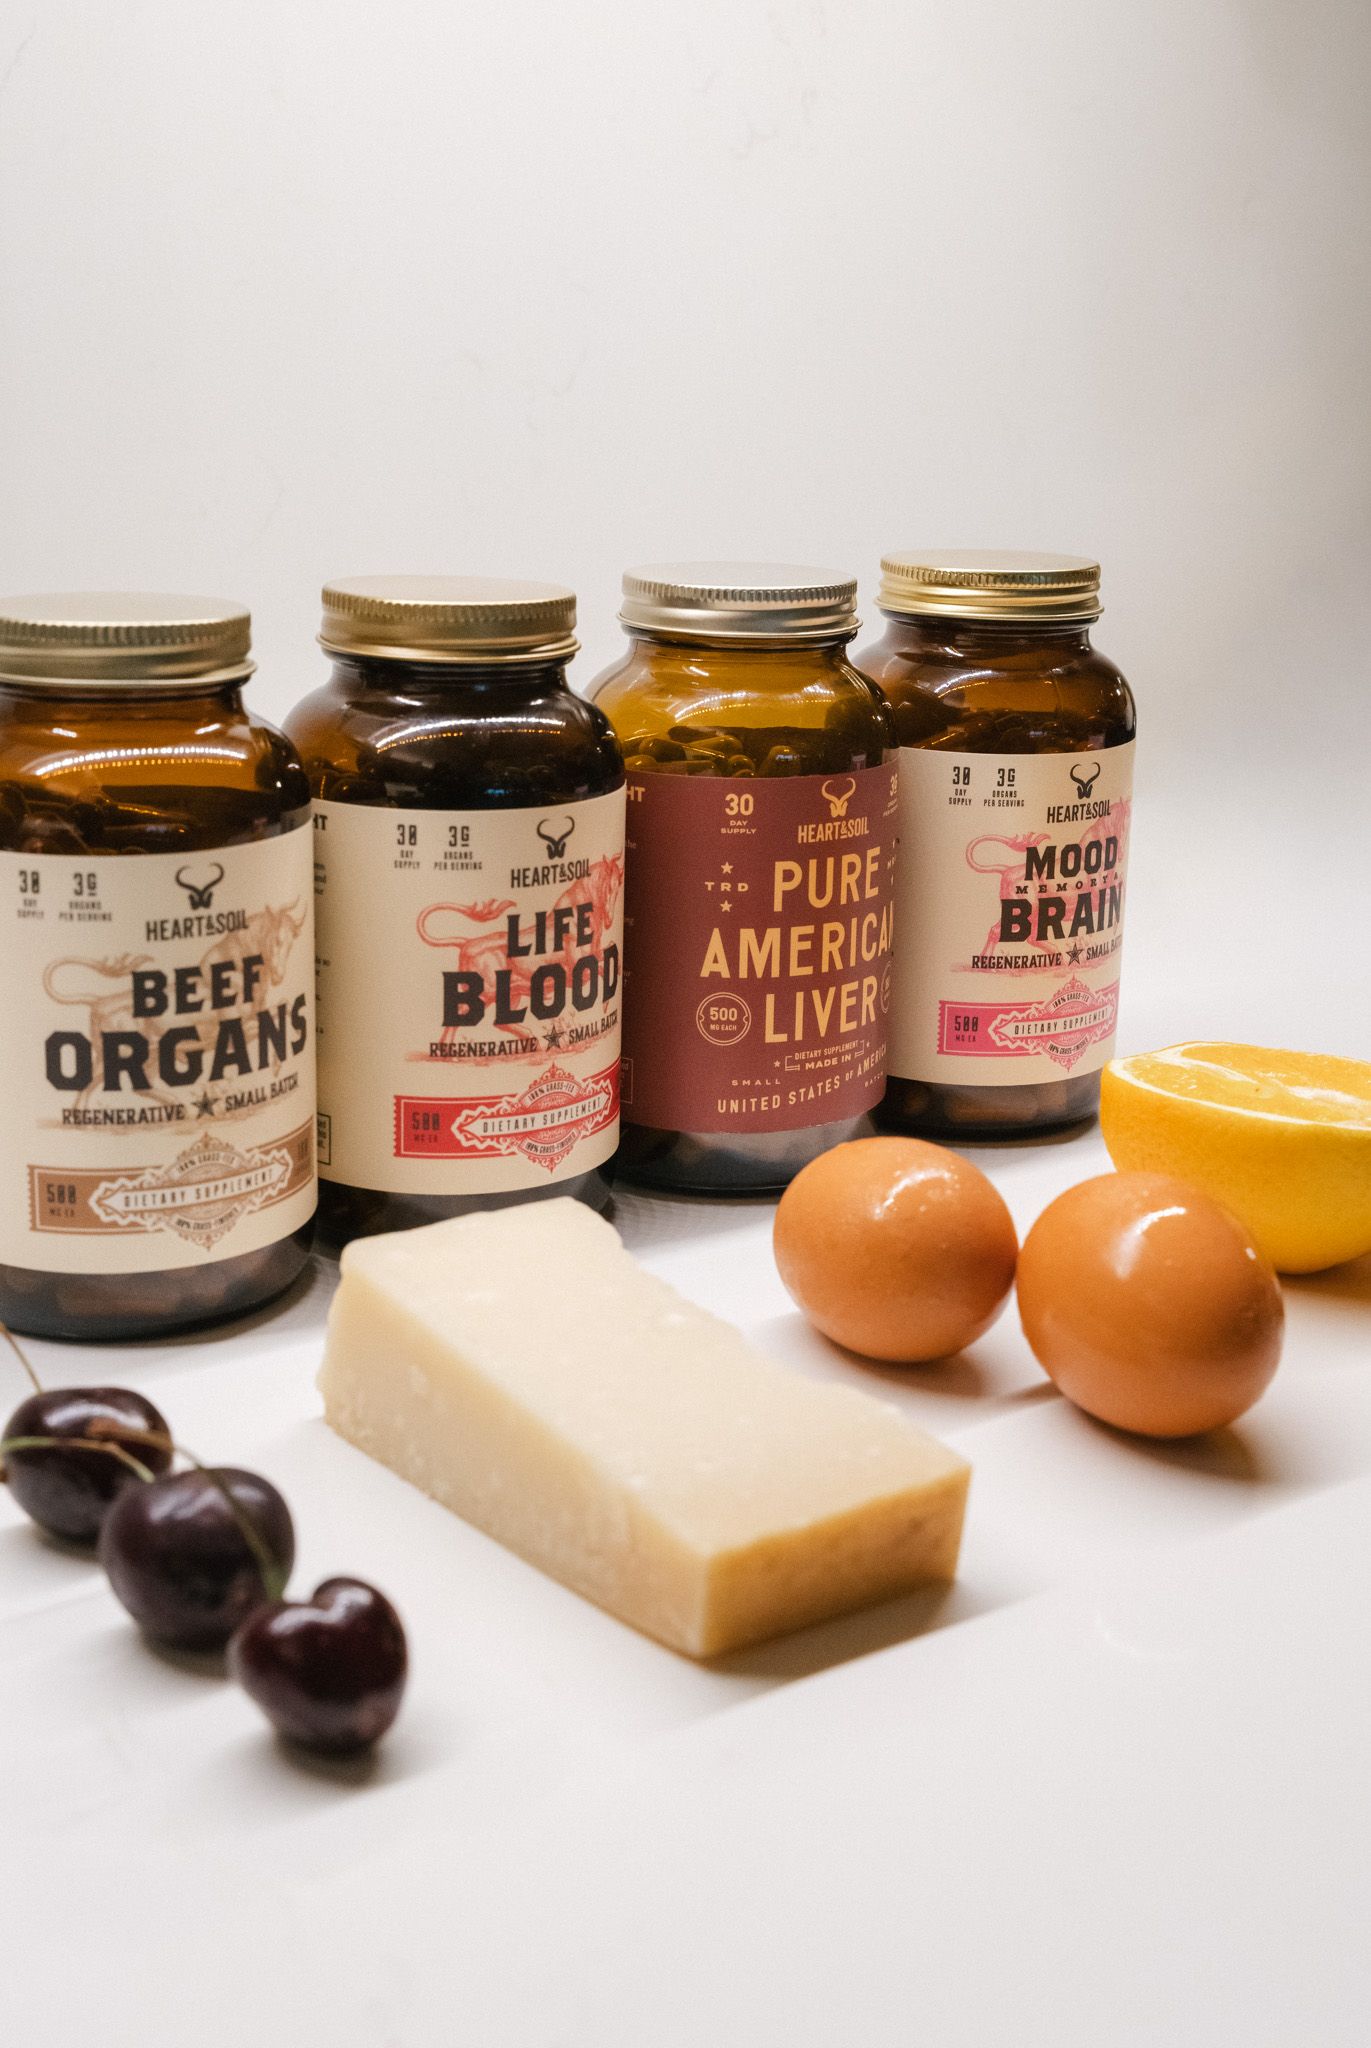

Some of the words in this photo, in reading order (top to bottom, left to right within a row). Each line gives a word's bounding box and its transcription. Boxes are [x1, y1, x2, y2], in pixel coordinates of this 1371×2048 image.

[953, 766, 971, 785] 30
[997, 768, 1015, 787] 3G
[725, 793, 754, 816] 30
[948, 797, 972, 806] SUPPLY
[983, 799, 995, 807] PER
[998, 799, 1024, 807] SERVING
[992, 790, 1017, 798] ORGANS
[1046, 800, 1112, 823] HEART&SOIL
[397, 824, 417, 846] 30
[449, 826, 470, 847] 3G
[798, 817, 869, 843] HEART&SOIL
[1024, 836, 1118, 881] MOOD
[74, 873, 97, 896] 3G
[510, 859, 591, 888] HEART&SOIL
[773, 847, 880, 913] PURE
[1015, 875, 1109, 895] MEMORY
[146, 909, 249, 941] HEART&SOIL
[999, 881, 1123, 942] BRAIN
[507, 902, 594, 958] LIFE
[971, 953, 1062, 969] REGENERATIVE
[1086, 940, 1110, 960] SMALL
[132, 954, 265, 1018] BEEF
[442, 943, 619, 1027] BLOOD
[709, 1007, 738, 1021] 500
[764, 975, 878, 1043] LIVER
[1014, 1022, 1058, 1035] DIETARY
[1063, 1007, 1108, 1030] SUPPLEMENT
[954, 1016, 979, 1032] 500
[45, 993, 307, 1092] ORGANS
[429, 1037, 538, 1058] REGENERATIVE
[568, 1021, 599, 1044] SMALL
[795, 1046, 822, 1060] DIETARY
[824, 1040, 859, 1056] SUPPLEMENT
[805, 1057, 838, 1070] MADE
[841, 1053, 852, 1064] IN
[718, 1094, 781, 1113] UNITED
[788, 1075, 840, 1105] STATES
[845, 1070, 854, 1081] OF
[731, 1078, 781, 1086] SMALL
[62, 1104, 185, 1126] REGENERATIVE
[225, 1087, 267, 1112] SMALL
[483, 1117, 536, 1133] DIETARY
[543, 1096, 601, 1126] SUPPLEMENT
[124, 1189, 186, 1208] DIETARY
[195, 1169, 274, 1200] SUPPLEMENT
